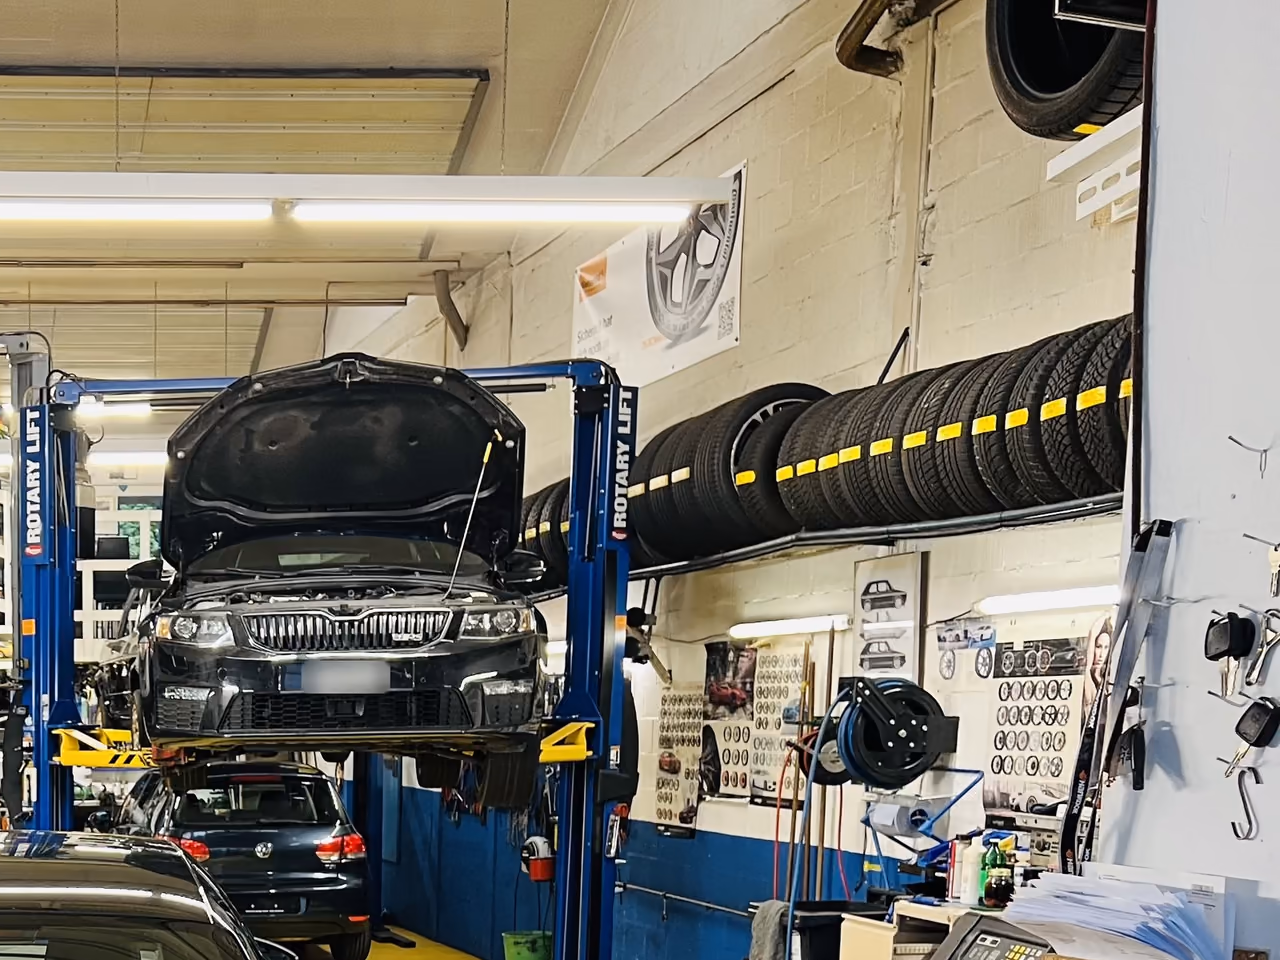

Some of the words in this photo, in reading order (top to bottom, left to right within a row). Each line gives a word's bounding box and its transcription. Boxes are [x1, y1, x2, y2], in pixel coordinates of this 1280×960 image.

[26, 408, 40, 453] LIFT
[617, 387, 633, 434] LIFT
[26, 459, 43, 544] ROTARY
[613, 440, 630, 528] ROTARY
